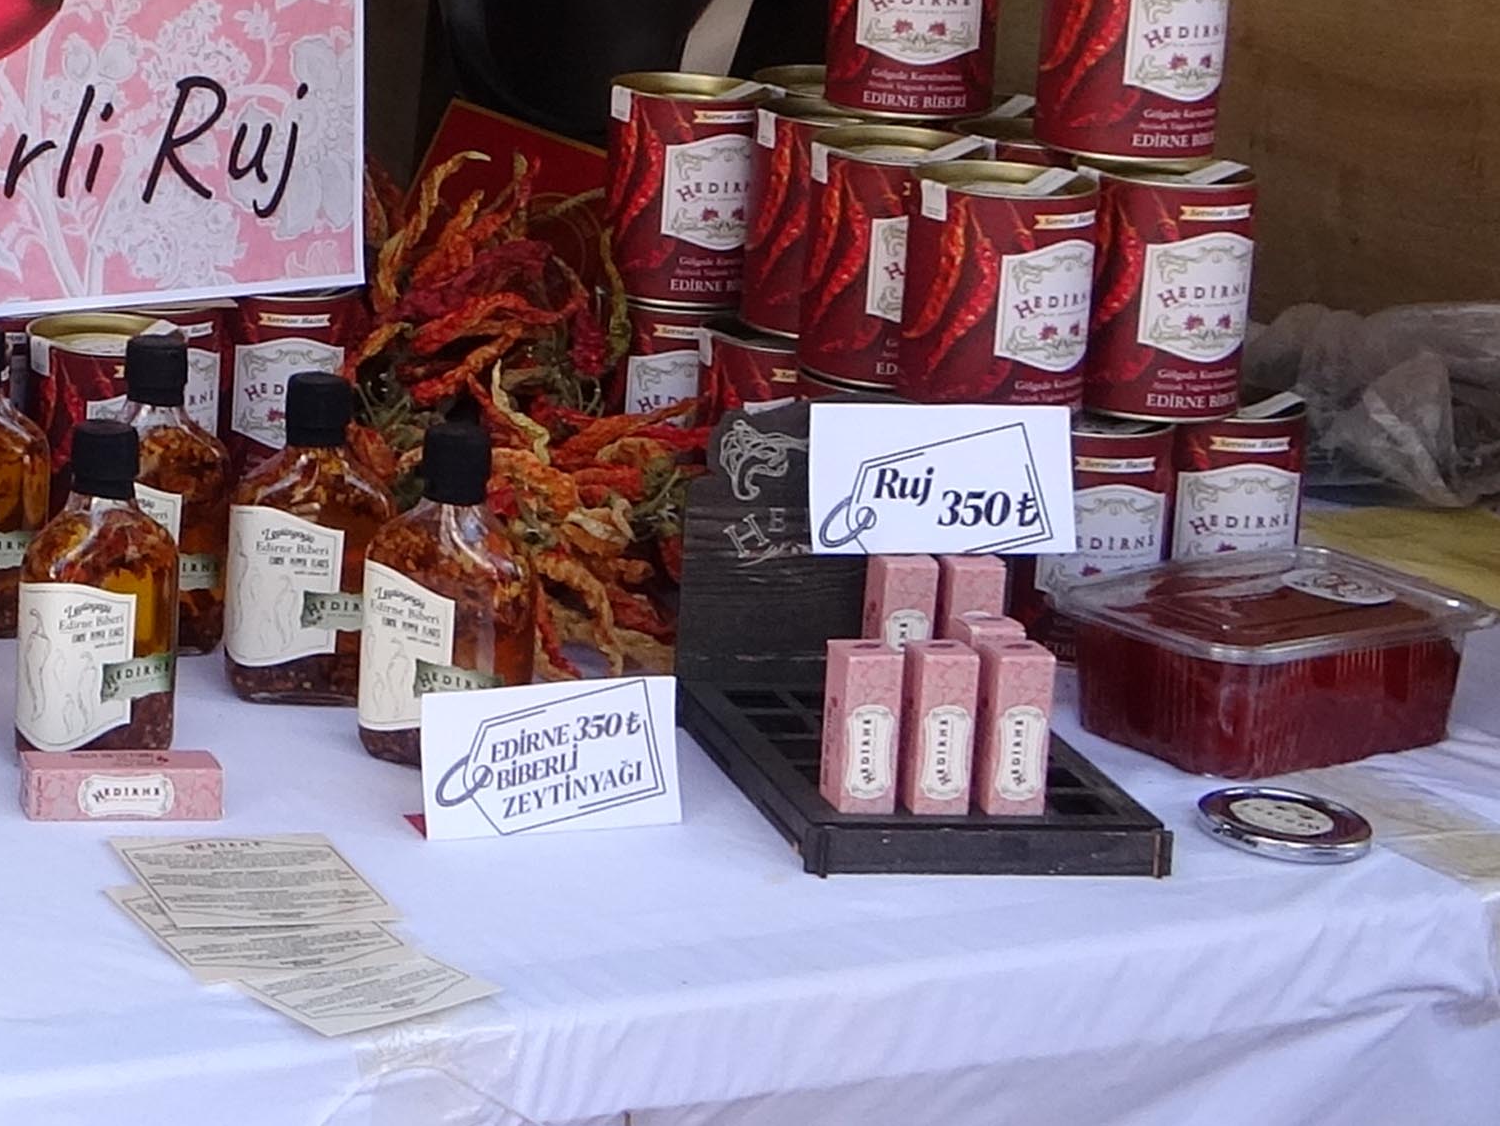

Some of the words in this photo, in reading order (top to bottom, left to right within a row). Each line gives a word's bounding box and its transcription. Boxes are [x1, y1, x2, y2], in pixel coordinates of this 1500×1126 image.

[141, 77, 309, 219] Ruj
[872, 466, 935, 507] Ruj
[490, 722, 570, 765] EDİRNE
[495, 742, 579, 792] BİBERLİ
[501, 759, 643, 820] ZEYTİNYAĞI
